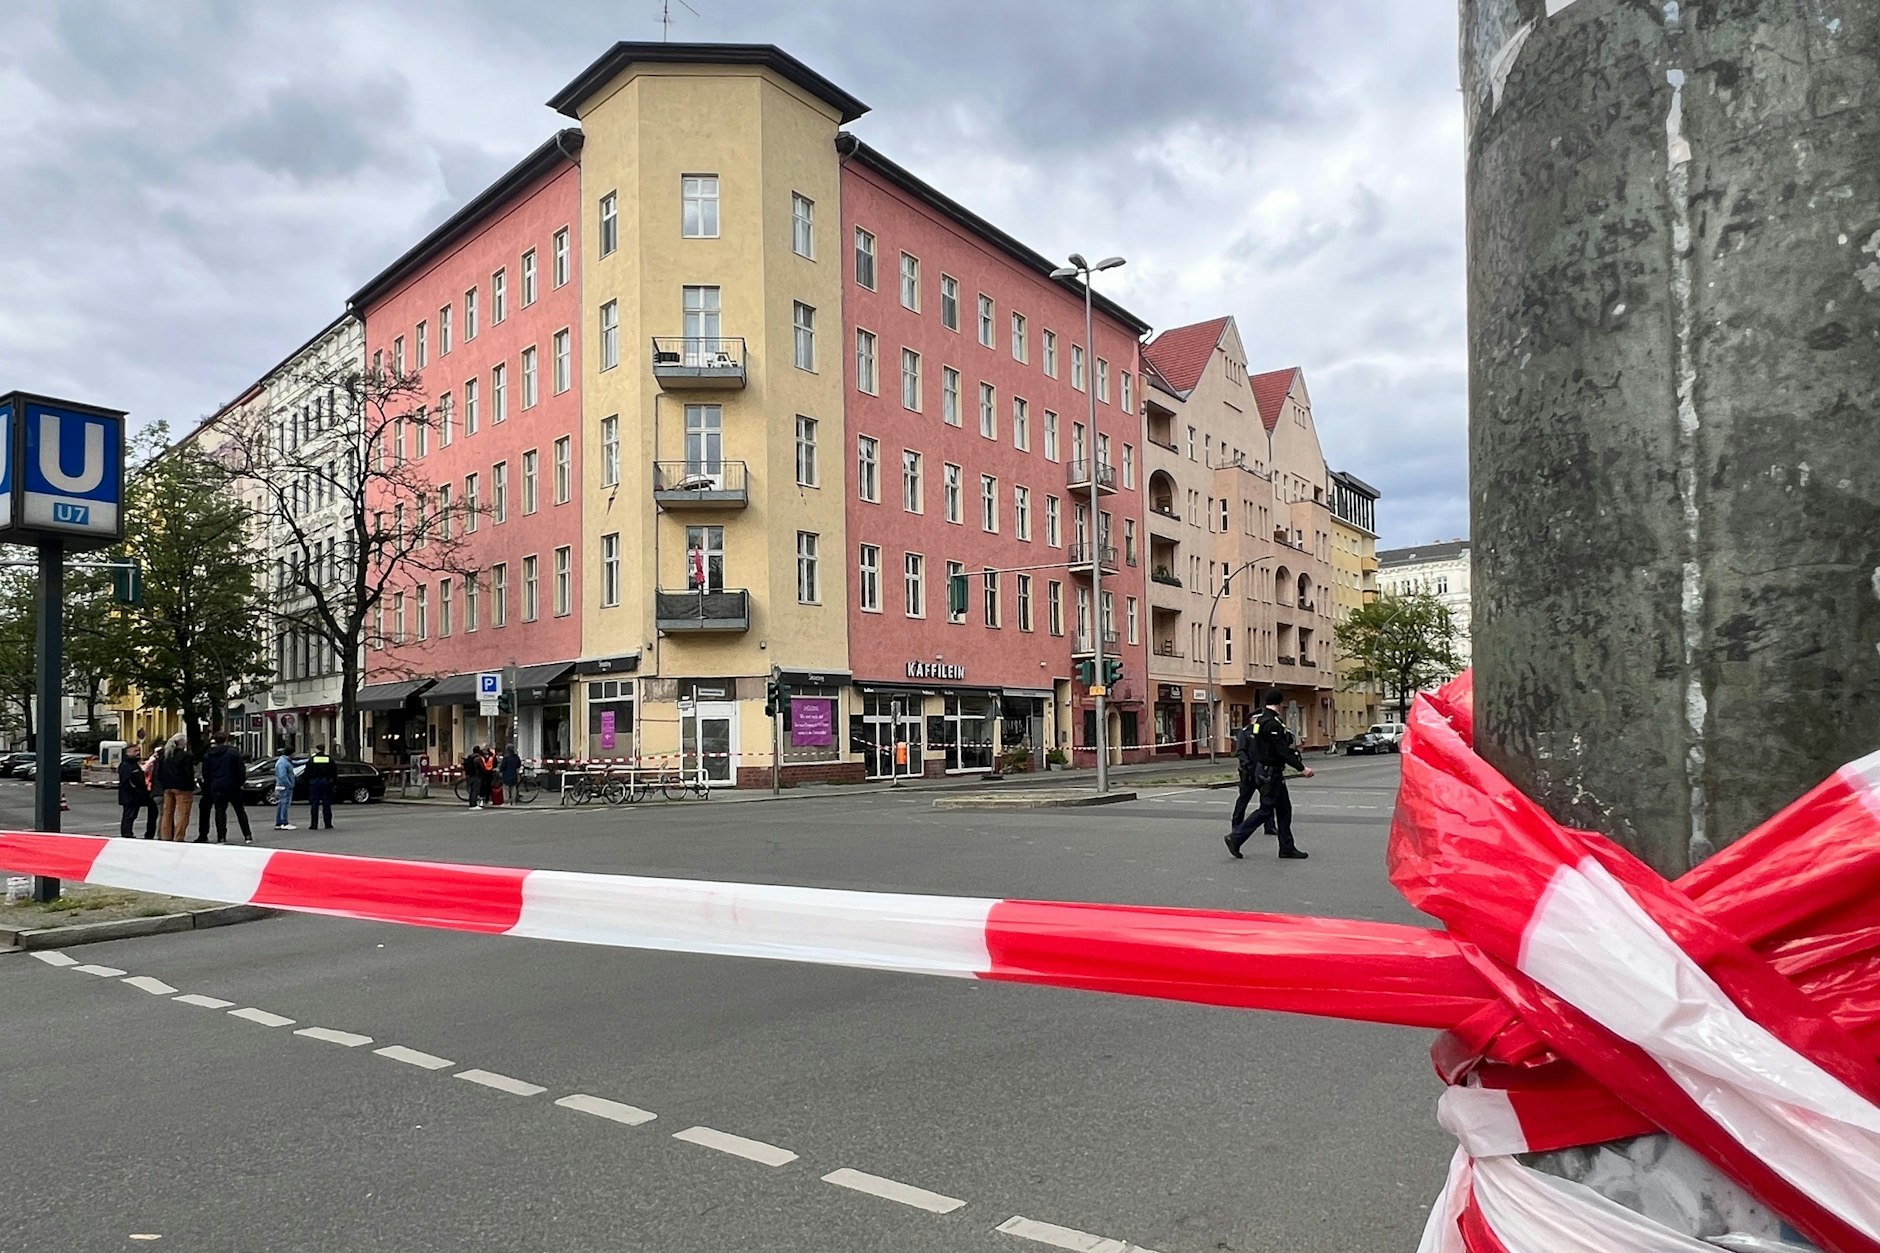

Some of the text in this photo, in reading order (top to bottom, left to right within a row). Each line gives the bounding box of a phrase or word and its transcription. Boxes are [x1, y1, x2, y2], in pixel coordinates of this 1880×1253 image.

[39, 414, 104, 493] U
[57, 505, 86, 523] U7
[484, 677, 494, 691] P
